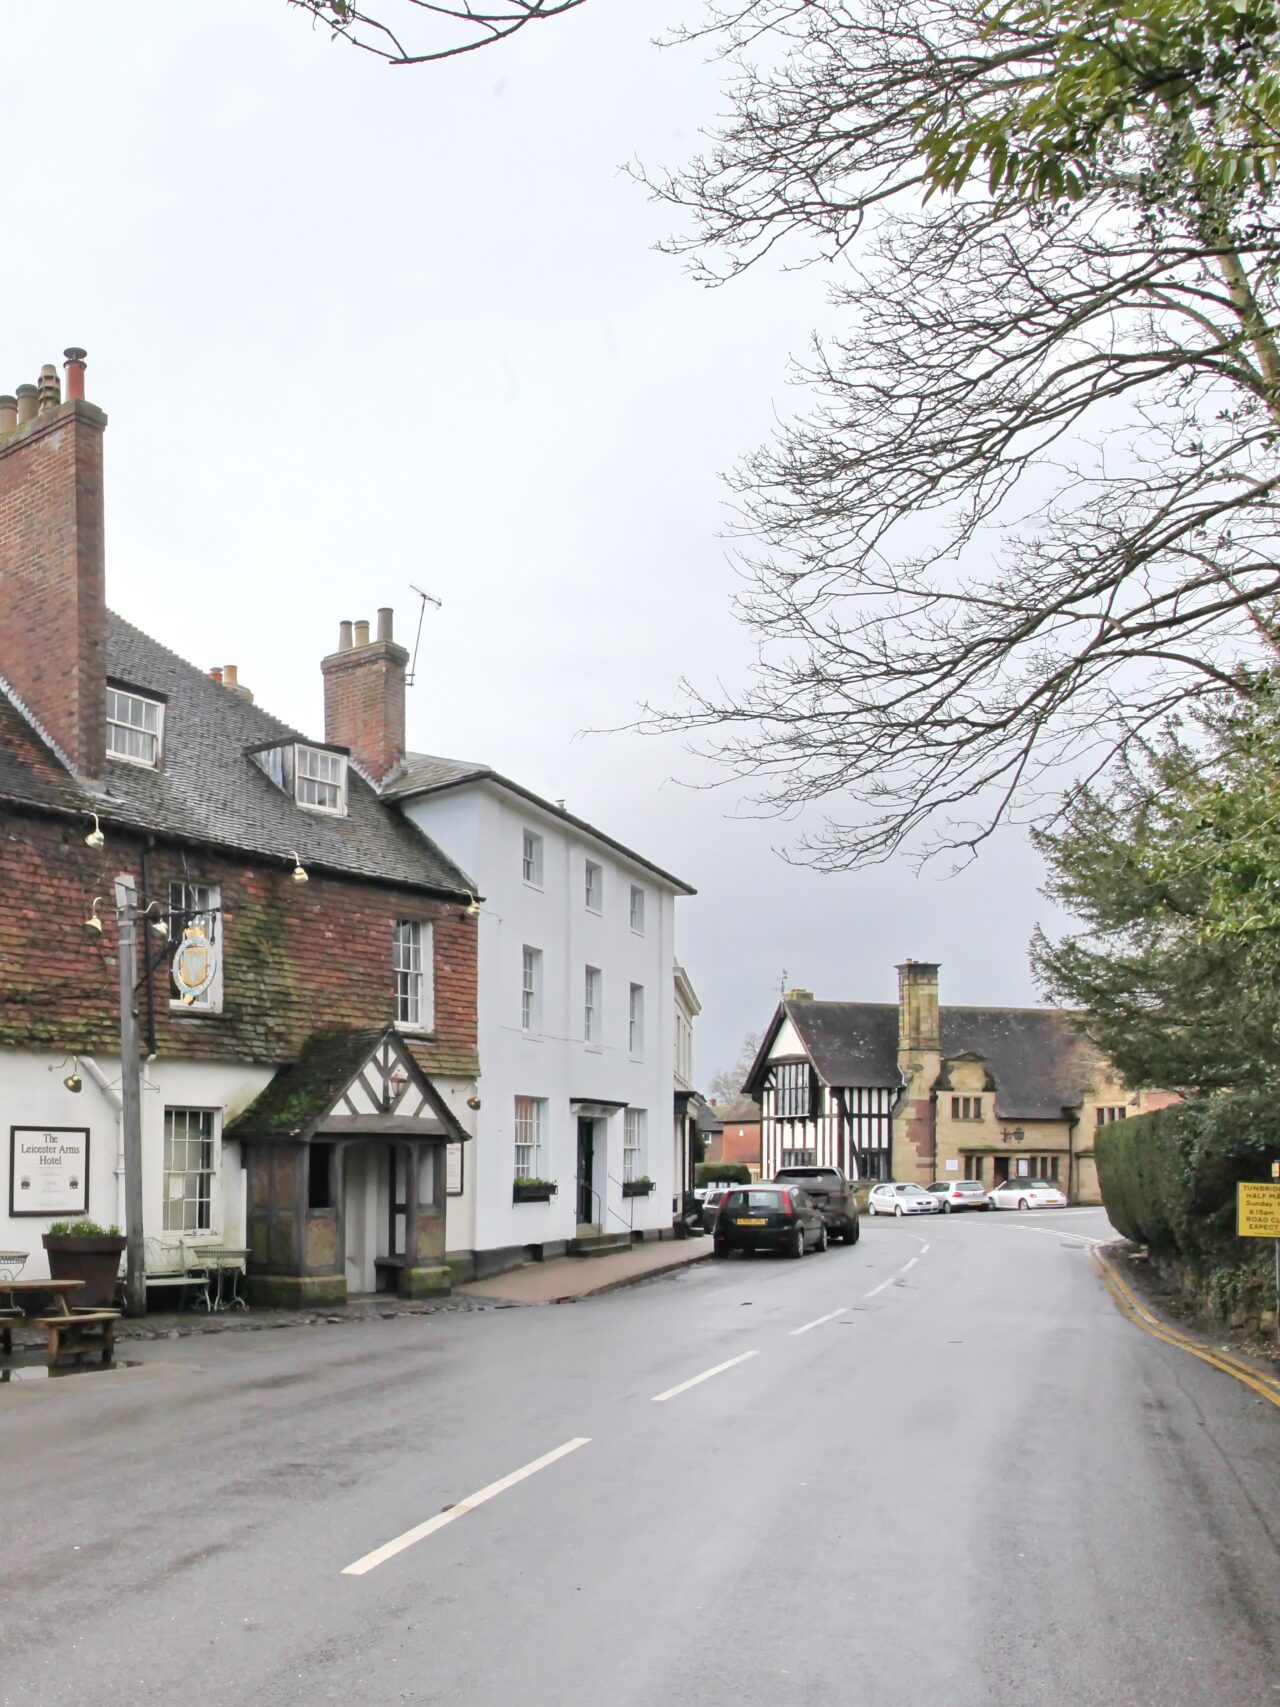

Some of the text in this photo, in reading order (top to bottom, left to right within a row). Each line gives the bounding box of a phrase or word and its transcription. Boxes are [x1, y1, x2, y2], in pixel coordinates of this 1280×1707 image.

[43, 1133, 58, 1143] The
[21, 1144, 80, 1154] Leicester Arms
[39, 1155, 62, 1165] Hotel
[1246, 1200, 1273, 1208] Sunday
